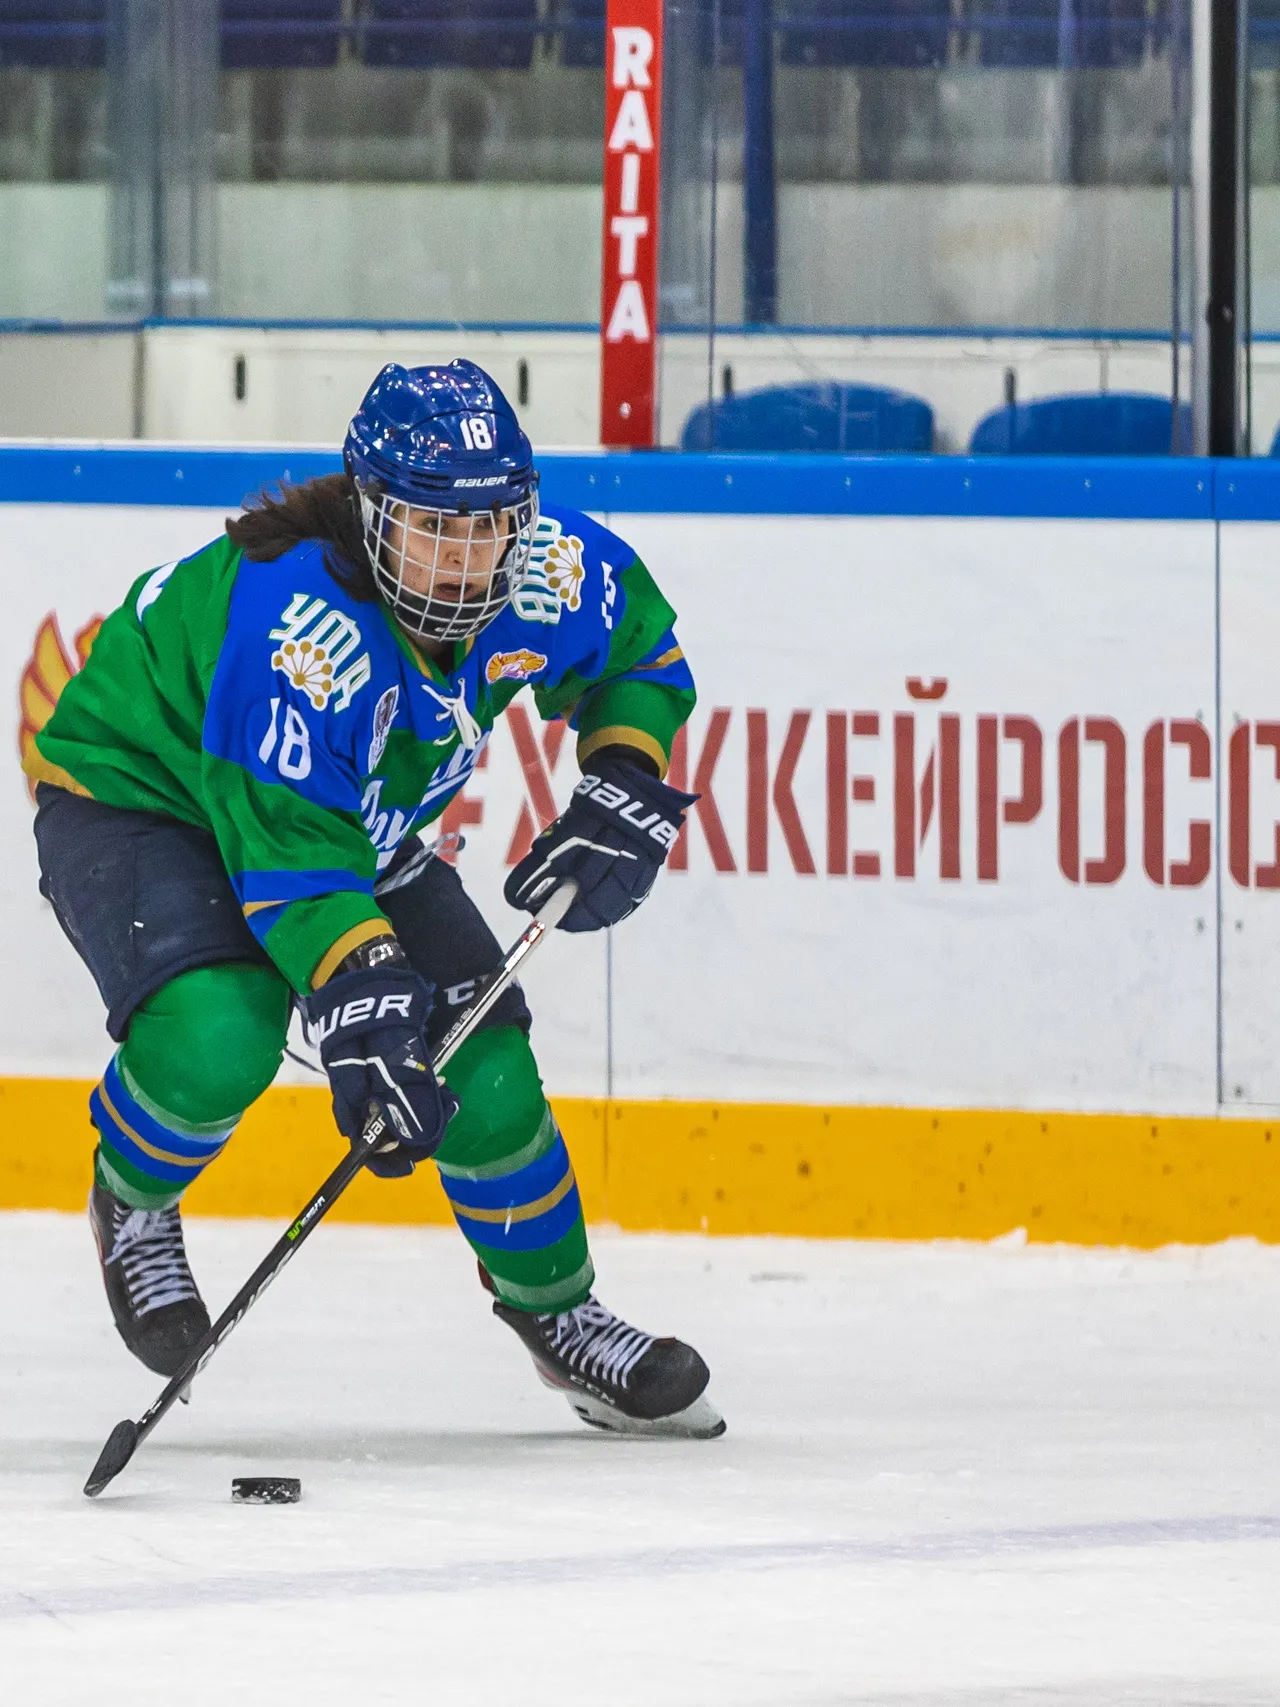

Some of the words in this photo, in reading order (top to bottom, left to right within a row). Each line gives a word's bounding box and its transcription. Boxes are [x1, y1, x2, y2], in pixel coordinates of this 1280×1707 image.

[607, 26, 653, 343] RAITA
[459, 417, 494, 451] 18
[453, 475, 508, 489] BAUER
[258, 697, 312, 780] 18
[430, 674, 1280, 889] ХККЕЙРОСС
